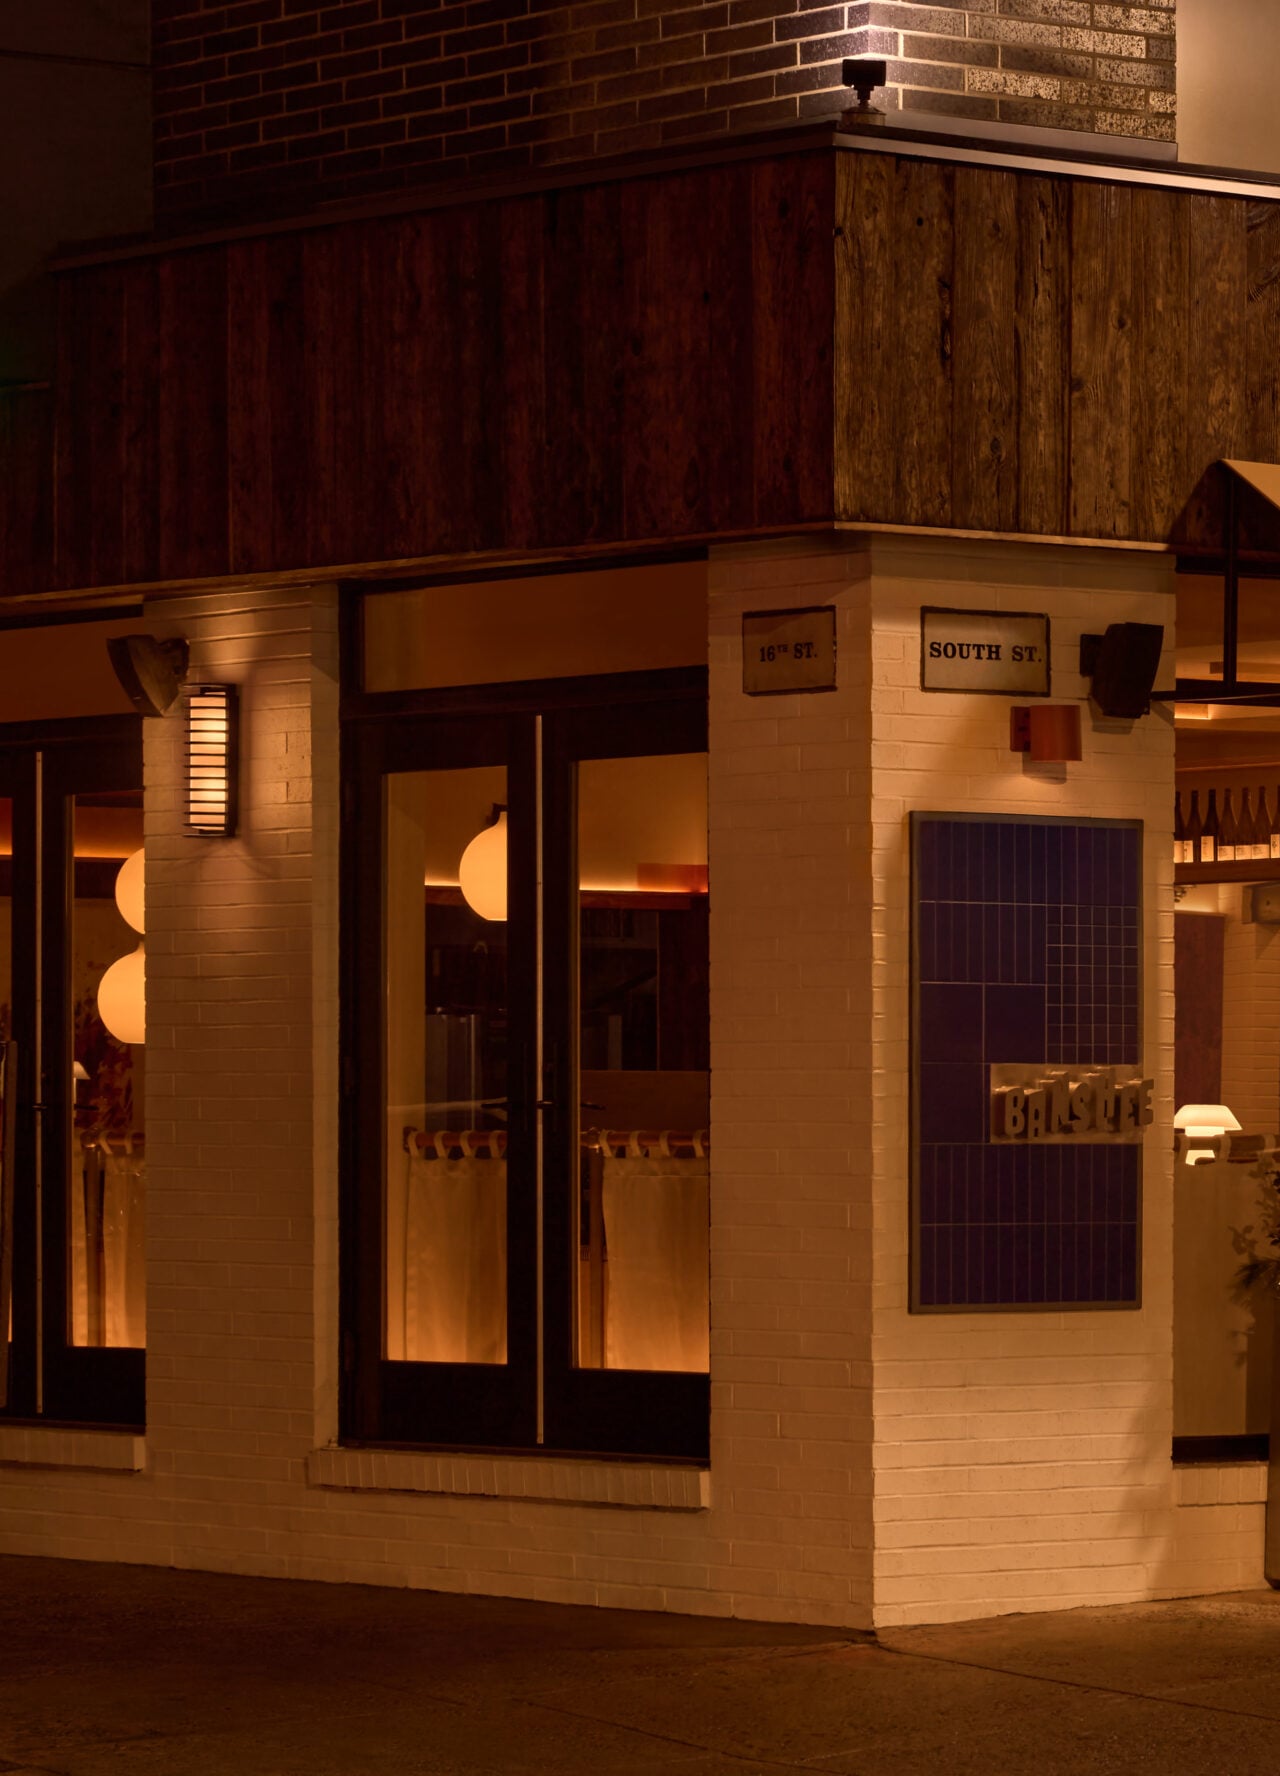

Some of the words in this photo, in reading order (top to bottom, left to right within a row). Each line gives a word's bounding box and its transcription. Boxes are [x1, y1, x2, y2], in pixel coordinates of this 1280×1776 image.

[759, 643, 788, 662] 16TH
[794, 642, 818, 659] ST.
[929, 641, 1001, 661] SOUTH
[1011, 645, 1043, 663] ST.
[1004, 1070, 1155, 1138] BANSHEE
